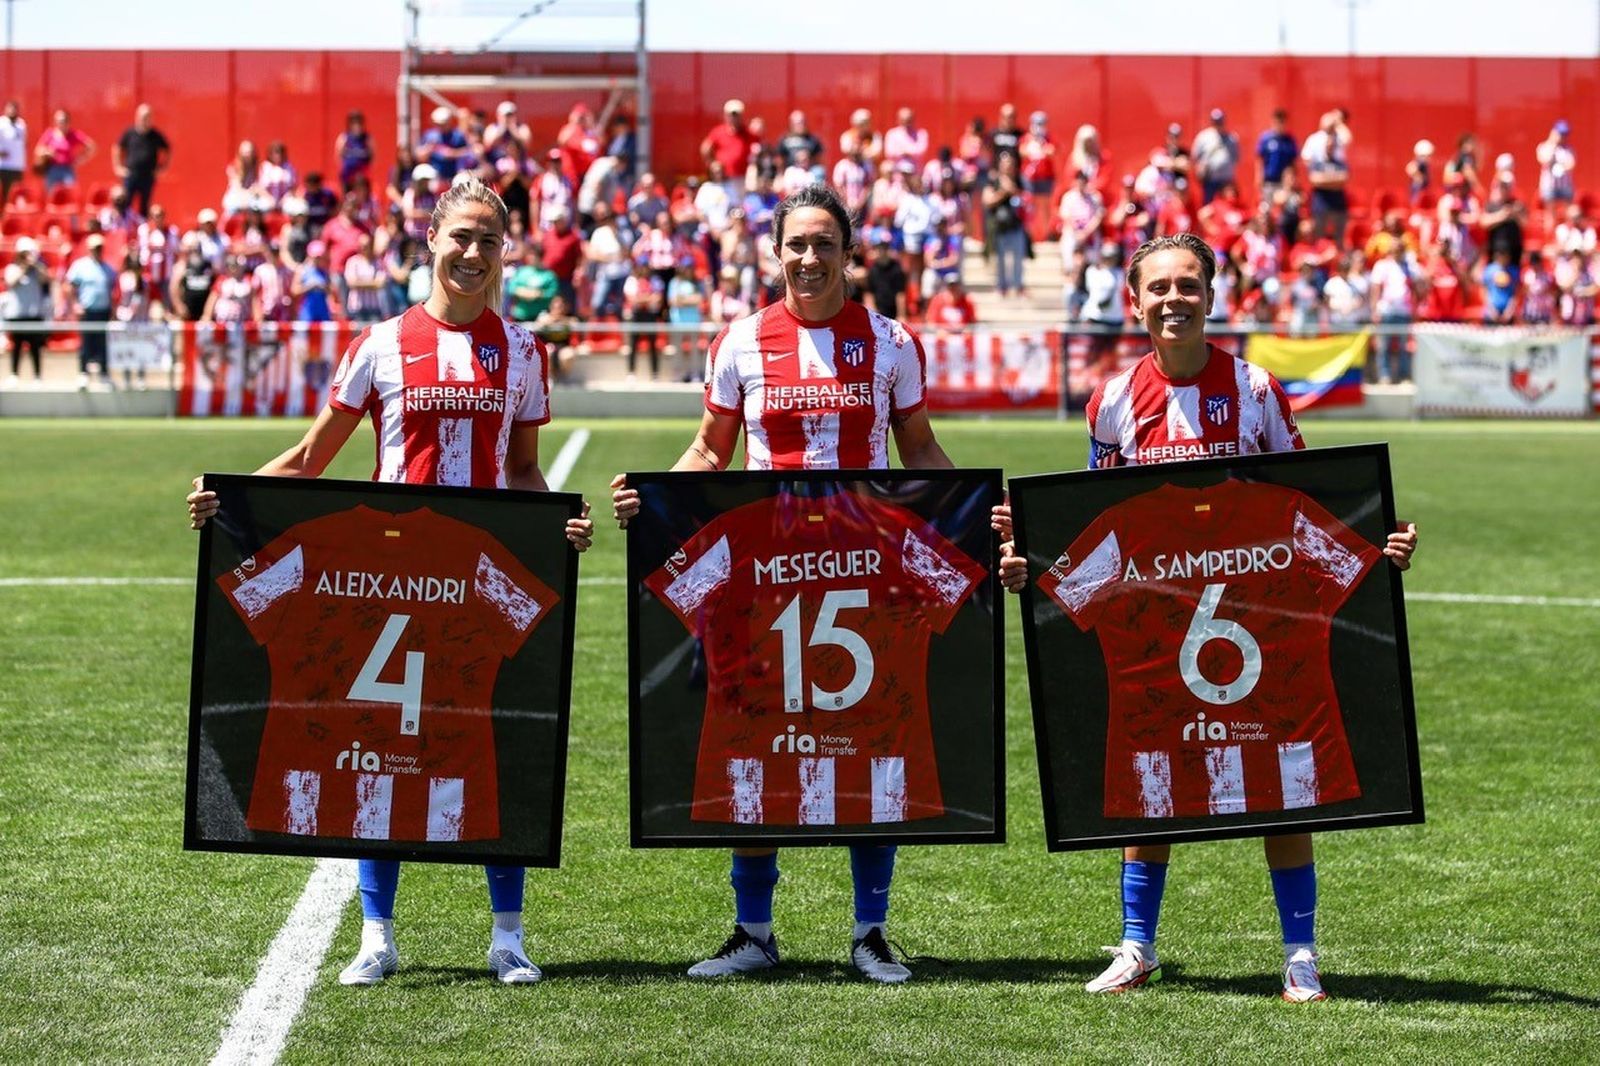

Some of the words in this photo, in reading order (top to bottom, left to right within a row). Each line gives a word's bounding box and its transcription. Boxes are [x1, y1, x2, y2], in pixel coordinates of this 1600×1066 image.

[406, 386, 504, 400] HERBALIFE
[766, 383, 870, 397] HERBALIFE
[406, 399, 503, 412] NUTRITION
[766, 394, 872, 410] NUTRITION
[1138, 442, 1236, 460] HERBALIFE
[754, 549, 881, 585] MESEGUER
[1123, 557, 1147, 582] A.
[1155, 543, 1293, 580] SAMPEDRO
[314, 570, 466, 604] ALEIXANDRI
[770, 589, 874, 713] 15
[1179, 583, 1262, 705] 6
[346, 614, 425, 735] 4
[1183, 711, 1227, 741] ria
[1230, 721, 1264, 732] Money
[772, 724, 816, 753] ria
[820, 735, 853, 746] Money
[1230, 731, 1270, 741] Transfer
[336, 741, 380, 772] ria
[384, 753, 418, 765] Money
[820, 745, 858, 756] Transfer
[384, 763, 422, 774] Transfer
